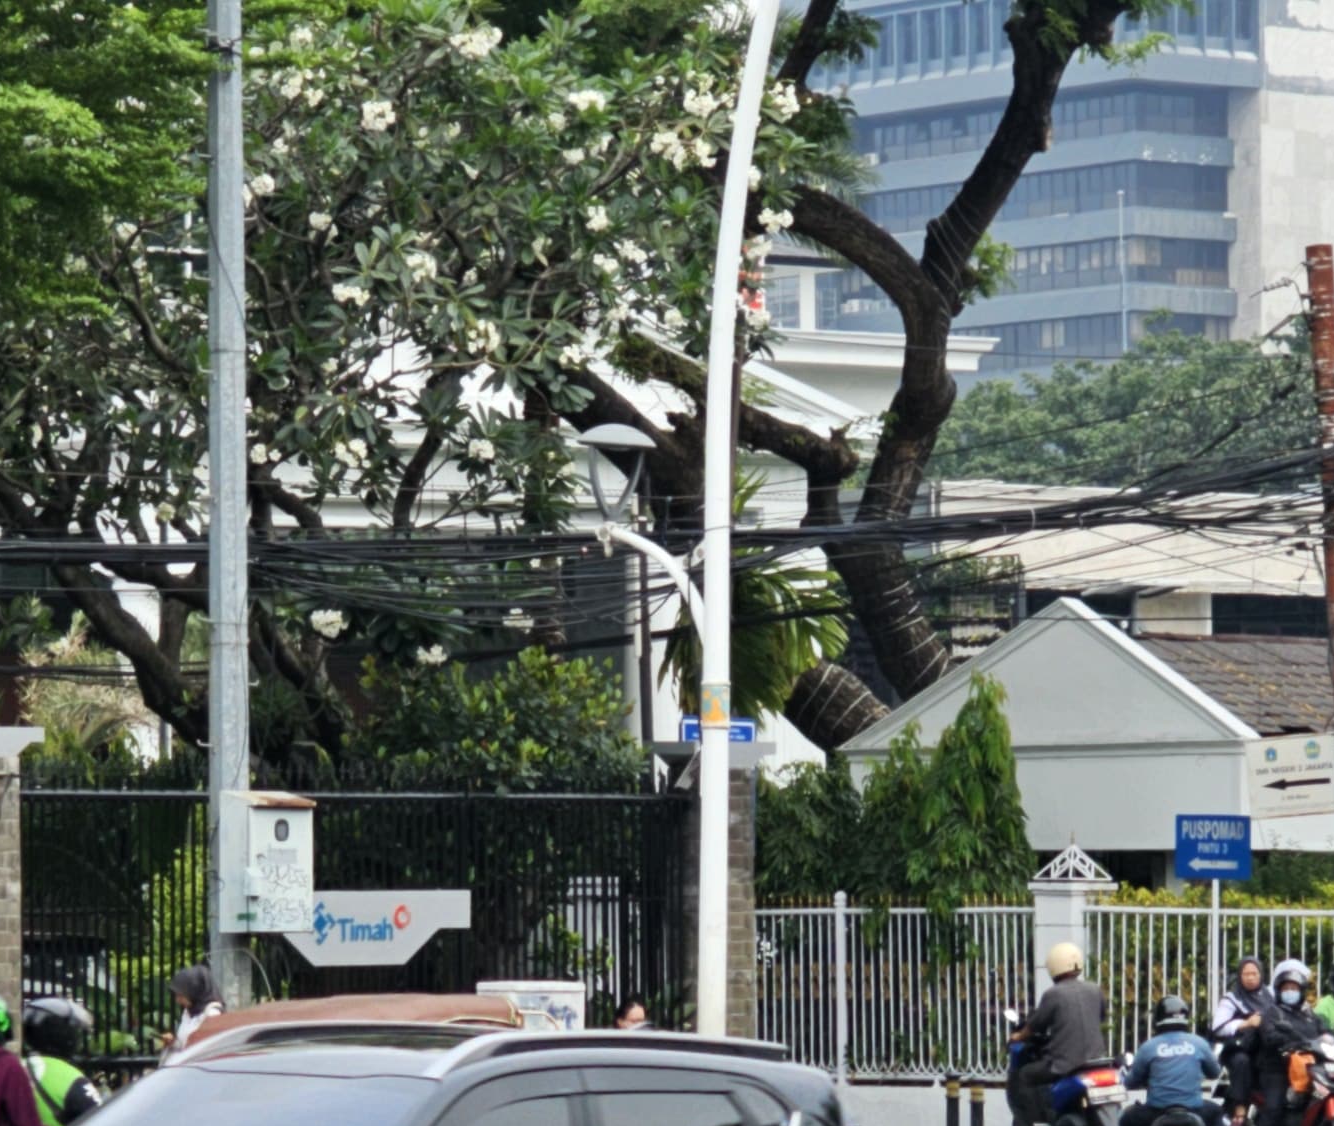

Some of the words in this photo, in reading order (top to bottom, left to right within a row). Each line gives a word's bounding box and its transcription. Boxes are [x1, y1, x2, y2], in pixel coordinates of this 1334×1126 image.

[1181, 820, 1245, 840] PUSPOMAD
[1197, 842, 1220, 855] PINTU
[337, 918, 394, 943] Timah
[1157, 1041, 1196, 1058] Grab
